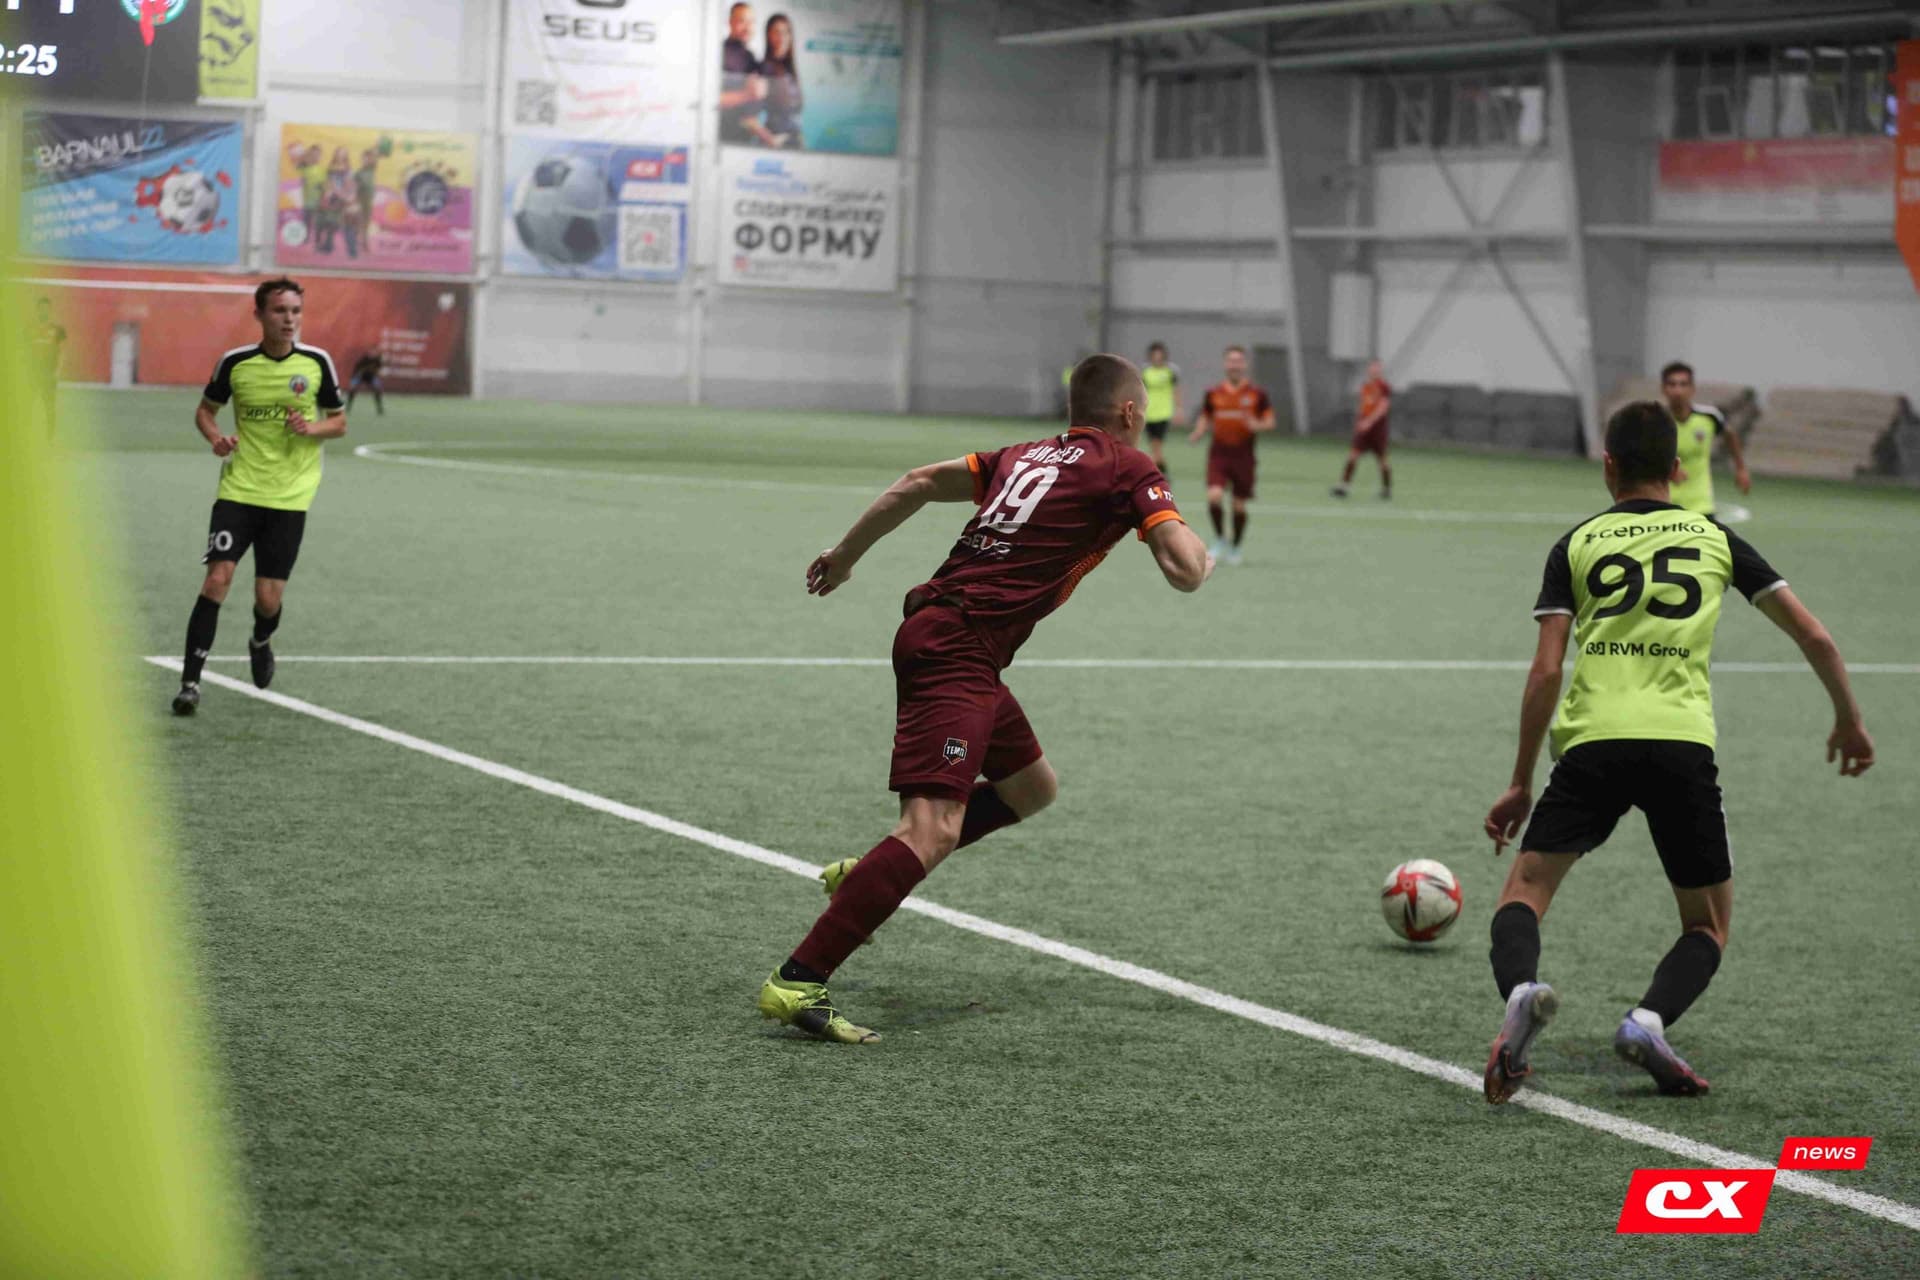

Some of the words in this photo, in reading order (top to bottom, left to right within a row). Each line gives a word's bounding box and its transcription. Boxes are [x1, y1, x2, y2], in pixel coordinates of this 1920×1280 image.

[544, 14, 656, 43] SEUS
[734, 222, 882, 260] ФОРМУ
[246, 405, 307, 419] ИРКУ
[978, 460, 1060, 534] 19
[1586, 546, 1702, 620] 95
[1609, 643, 1644, 657] RVM
[1649, 643, 1691, 660] Group
